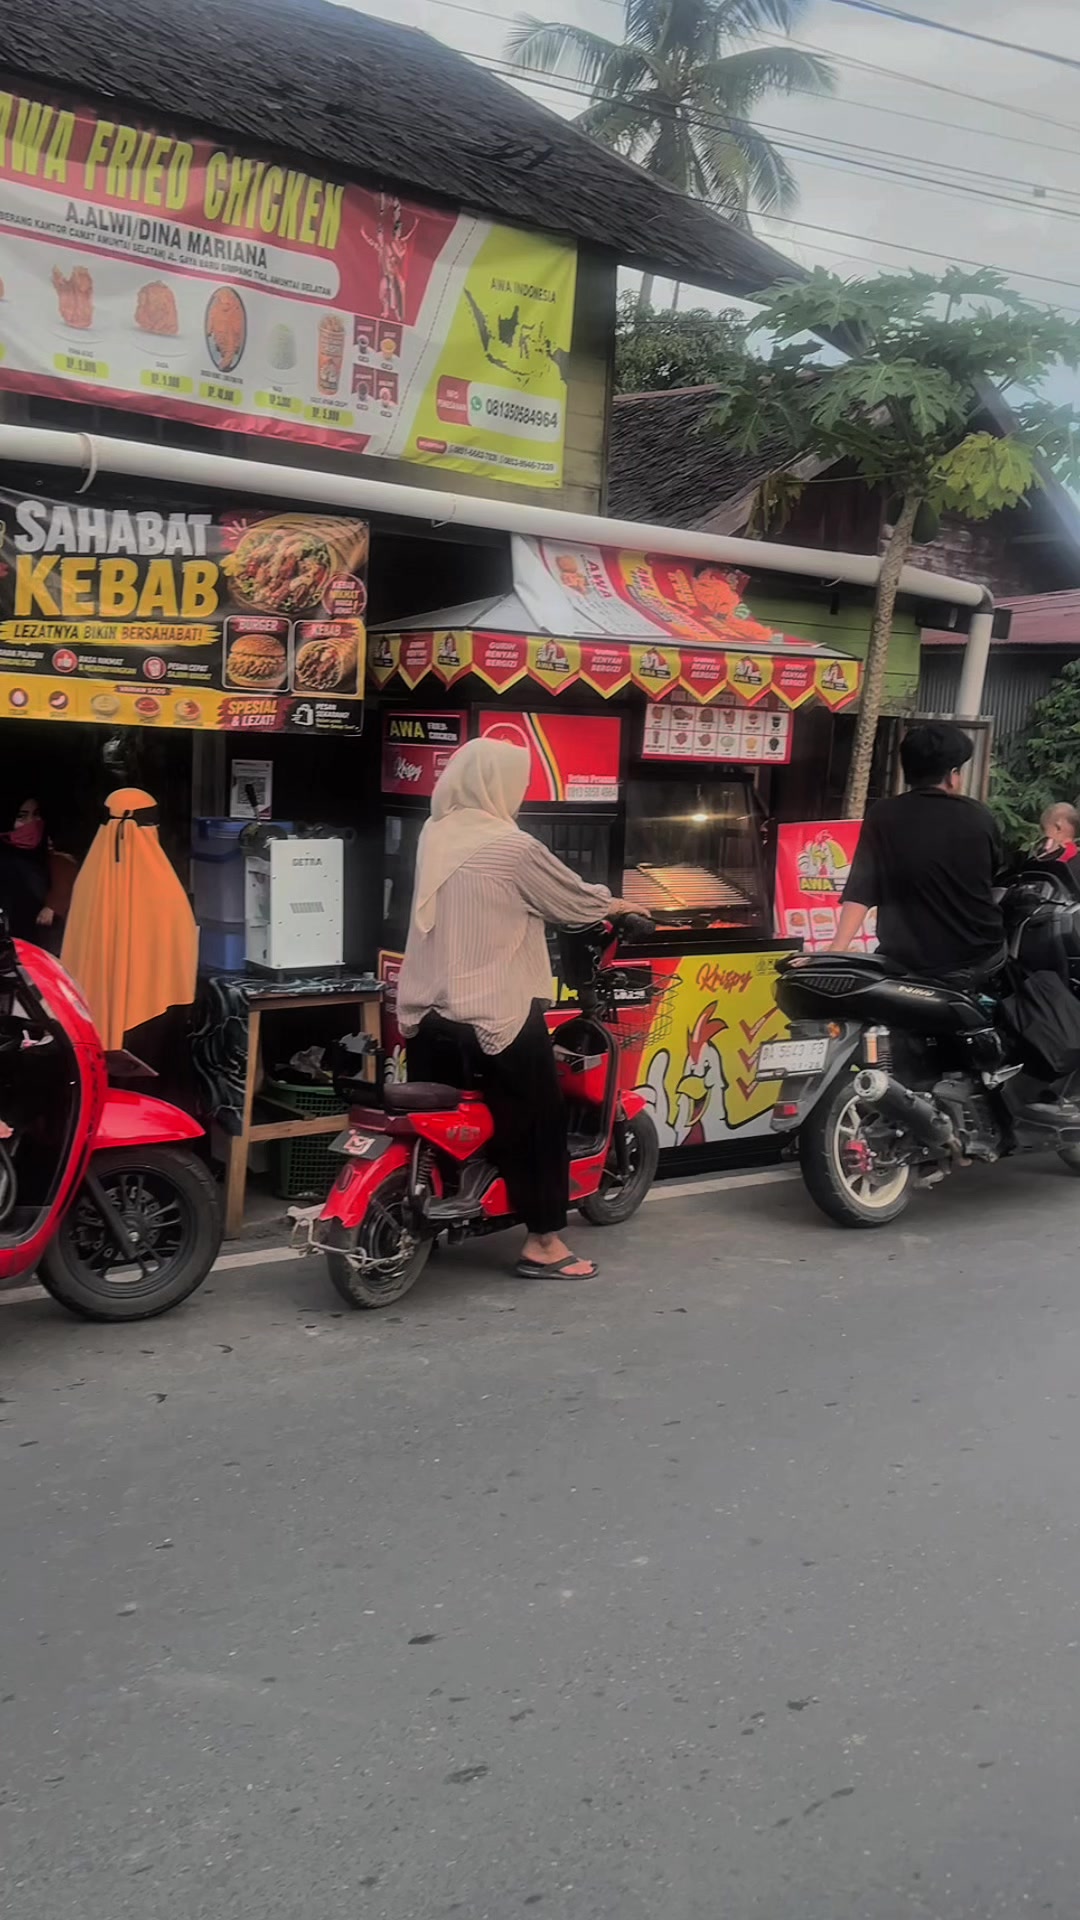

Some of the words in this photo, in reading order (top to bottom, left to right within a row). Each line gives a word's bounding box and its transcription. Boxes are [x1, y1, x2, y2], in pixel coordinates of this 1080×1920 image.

[84, 119, 193, 210] FRIED
[203, 152, 345, 250] CHICKEN
[34, 217, 67, 234] KANTOR
[65, 201, 181, 250] A.ALWI/DINA
[187, 231, 268, 269] MARIANA
[490, 278, 512, 292] AWA
[514, 283, 556, 304] INDONESIA
[14, 500, 212, 557] SAHABAT
[14, 554, 219, 619] KEBAB
[13, 624, 80, 639] LEZATNYA
[84, 625, 118, 640] BIKIN
[121, 627, 202, 641] BERSAHABAT!
[238, 620, 278, 632] BURGER
[312, 624, 342, 636] KEBAB
[488, 641, 517, 650] GURIH
[484, 651, 518, 660] RENYAH
[485, 659, 518, 668] BERGIZI
[228, 700, 277, 715] SPESIAL
[231, 714, 239, 726] &
[241, 714, 275, 726] LEZAT!
[389, 720, 425, 739] AWA
[291, 858, 323, 867] GETRA
[801, 878, 834, 891] AWA
[696, 963, 752, 994] Krispy
